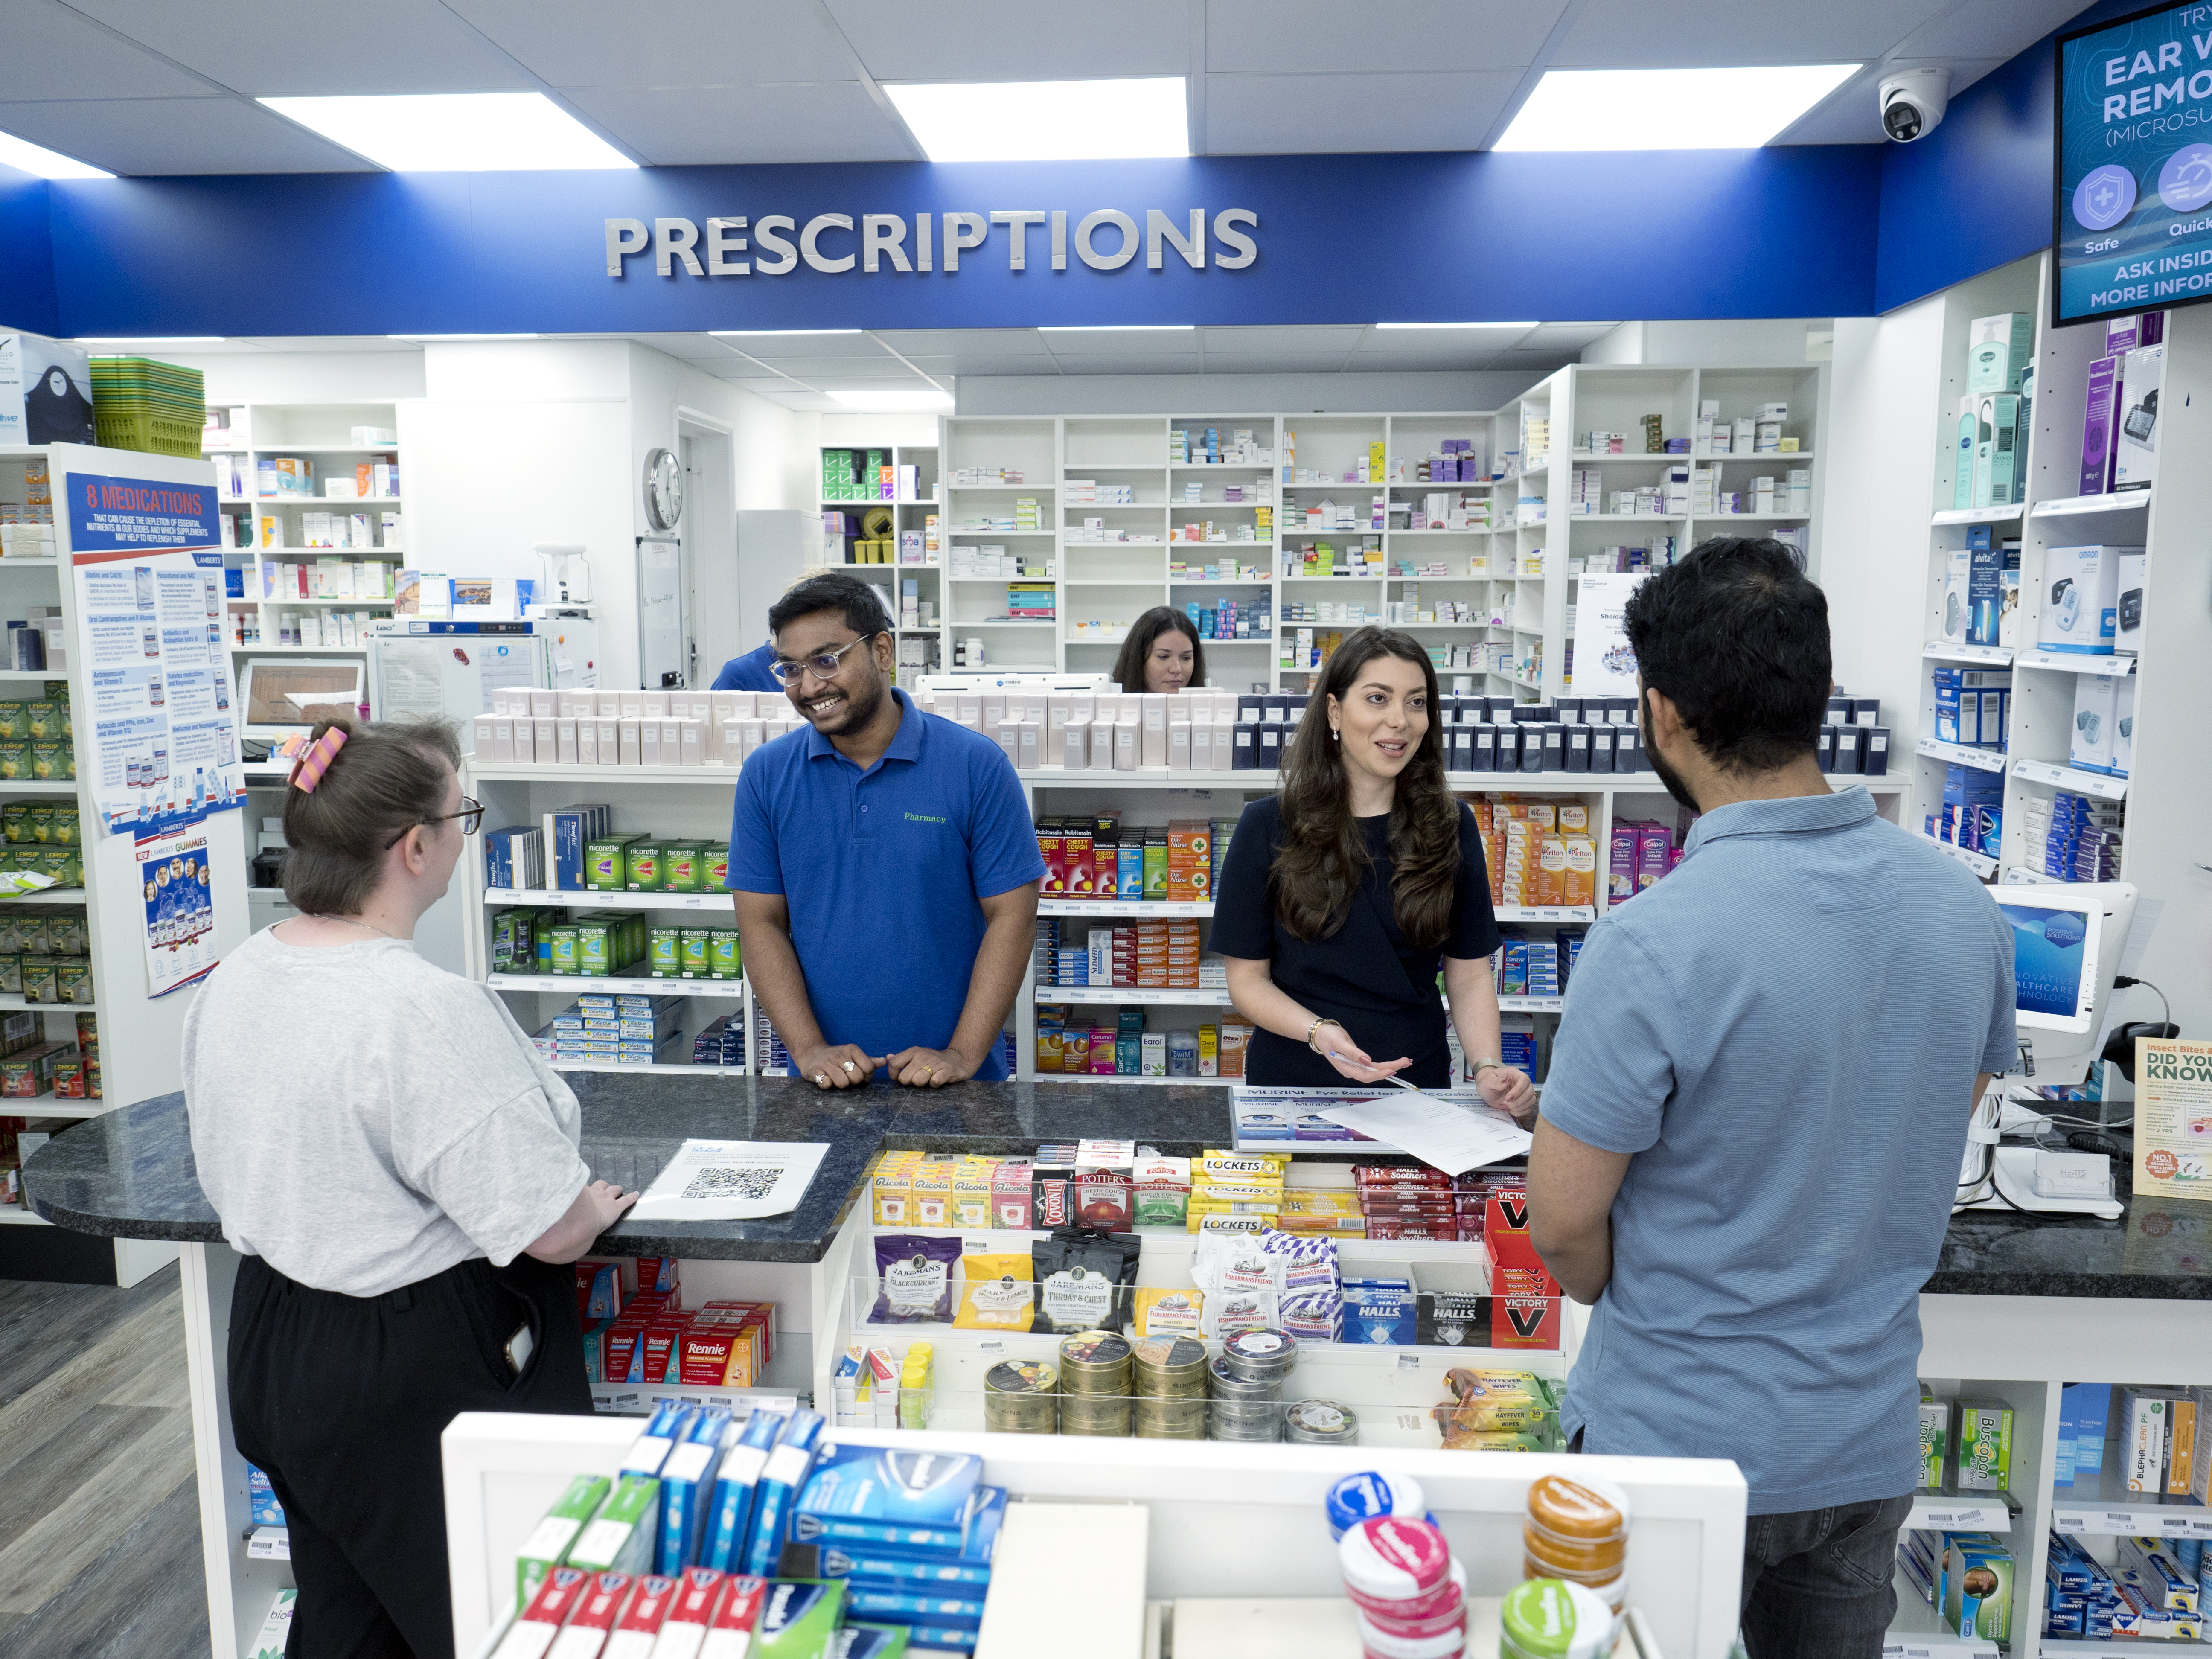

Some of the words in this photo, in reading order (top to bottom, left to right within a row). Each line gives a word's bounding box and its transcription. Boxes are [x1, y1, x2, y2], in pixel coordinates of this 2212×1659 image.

[2105, 41, 2182, 86] EAR
[2104, 70, 2212, 123] REMO
[2106, 105, 2212, 148] (MICROSU
[2169, 217, 2212, 237] Quick
[605, 209, 1258, 277] PRESCRIPTIONS
[2085, 238, 2119, 253] Safe
[2114, 260, 2155, 281] ASK
[2091, 284, 2149, 307] MORE
[2154, 271, 2212, 297] INFOR
[87, 484, 98, 508] 8
[102, 485, 203, 515] MEDICATIONS
[93, 514, 107, 522] THAT
[108, 515, 118, 523] CAN
[119, 515, 135, 524] CAUSE
[136, 516, 144, 524] THE
[146, 517, 170, 526] DEPLETION
[171, 518, 176, 527] OF
[178, 518, 201, 528] ESSENTIAL
[87, 523, 115, 532] NUTRIENTS
[116, 524, 121, 532] IN
[122, 524, 132, 533] OUR
[133, 525, 149, 533] BODIES
[151, 526, 160, 534] AND
[161, 526, 176, 535] WHICH
[177, 527, 208, 536] SUPPLEMENTS
[116, 533, 126, 541] MAY
[128, 533, 139, 542] HELP
[147, 535, 171, 543] REPLENISH
[172, 536, 185, 544] THEM
[902, 536, 919, 547] sma
[197, 556, 221, 564] LAMBERTS
[1975, 554, 1991, 562] alvita
[904, 812, 946, 824] Pharmacy
[160, 823, 183, 833] LAMBERTS
[151, 846, 173, 856] LAMBERTS
[175, 836, 207, 852] GUMMIES
[589, 844, 619, 853] nicorette
[2046, 933, 2081, 941] SOLUTIONS
[2147, 1044, 2177, 1052] Insect
[2180, 1045, 2204, 1054] Bites
[2147, 1053, 2177, 1064] DID
[2147, 1064, 2212, 1082] KNOW
[2152, 1154, 2172, 1162] NO.1
[1207, 1161, 1260, 1171] LOCKETS
[1082, 1174, 1125, 1185] POTTER'S
[1390, 1172, 1427, 1180] Soothers
[876, 1177, 909, 1187] Ricola
[914, 1179, 949, 1189] Ricola
[995, 1182, 1030, 1192] Ricola
[1045, 1181, 1064, 1225] COVONIA
[893, 1265, 941, 1275] JAKEMANS
[1225, 1273, 1254, 1283] FISHERMAN'S
[1048, 1291, 1076, 1303] THROAT
[1083, 1295, 1107, 1304] CHEST
[1505, 1298, 1548, 1307] VICTORY
[1505, 1308, 1548, 1337] V
[688, 1343, 725, 1355] Rennie
[2141, 1413, 2148, 1423] PF
[1976, 1417, 1995, 1479] Buscopan
[2137, 1425, 2147, 1479] BLEPHACLEAN
[271, 1610, 287, 1620] bio
